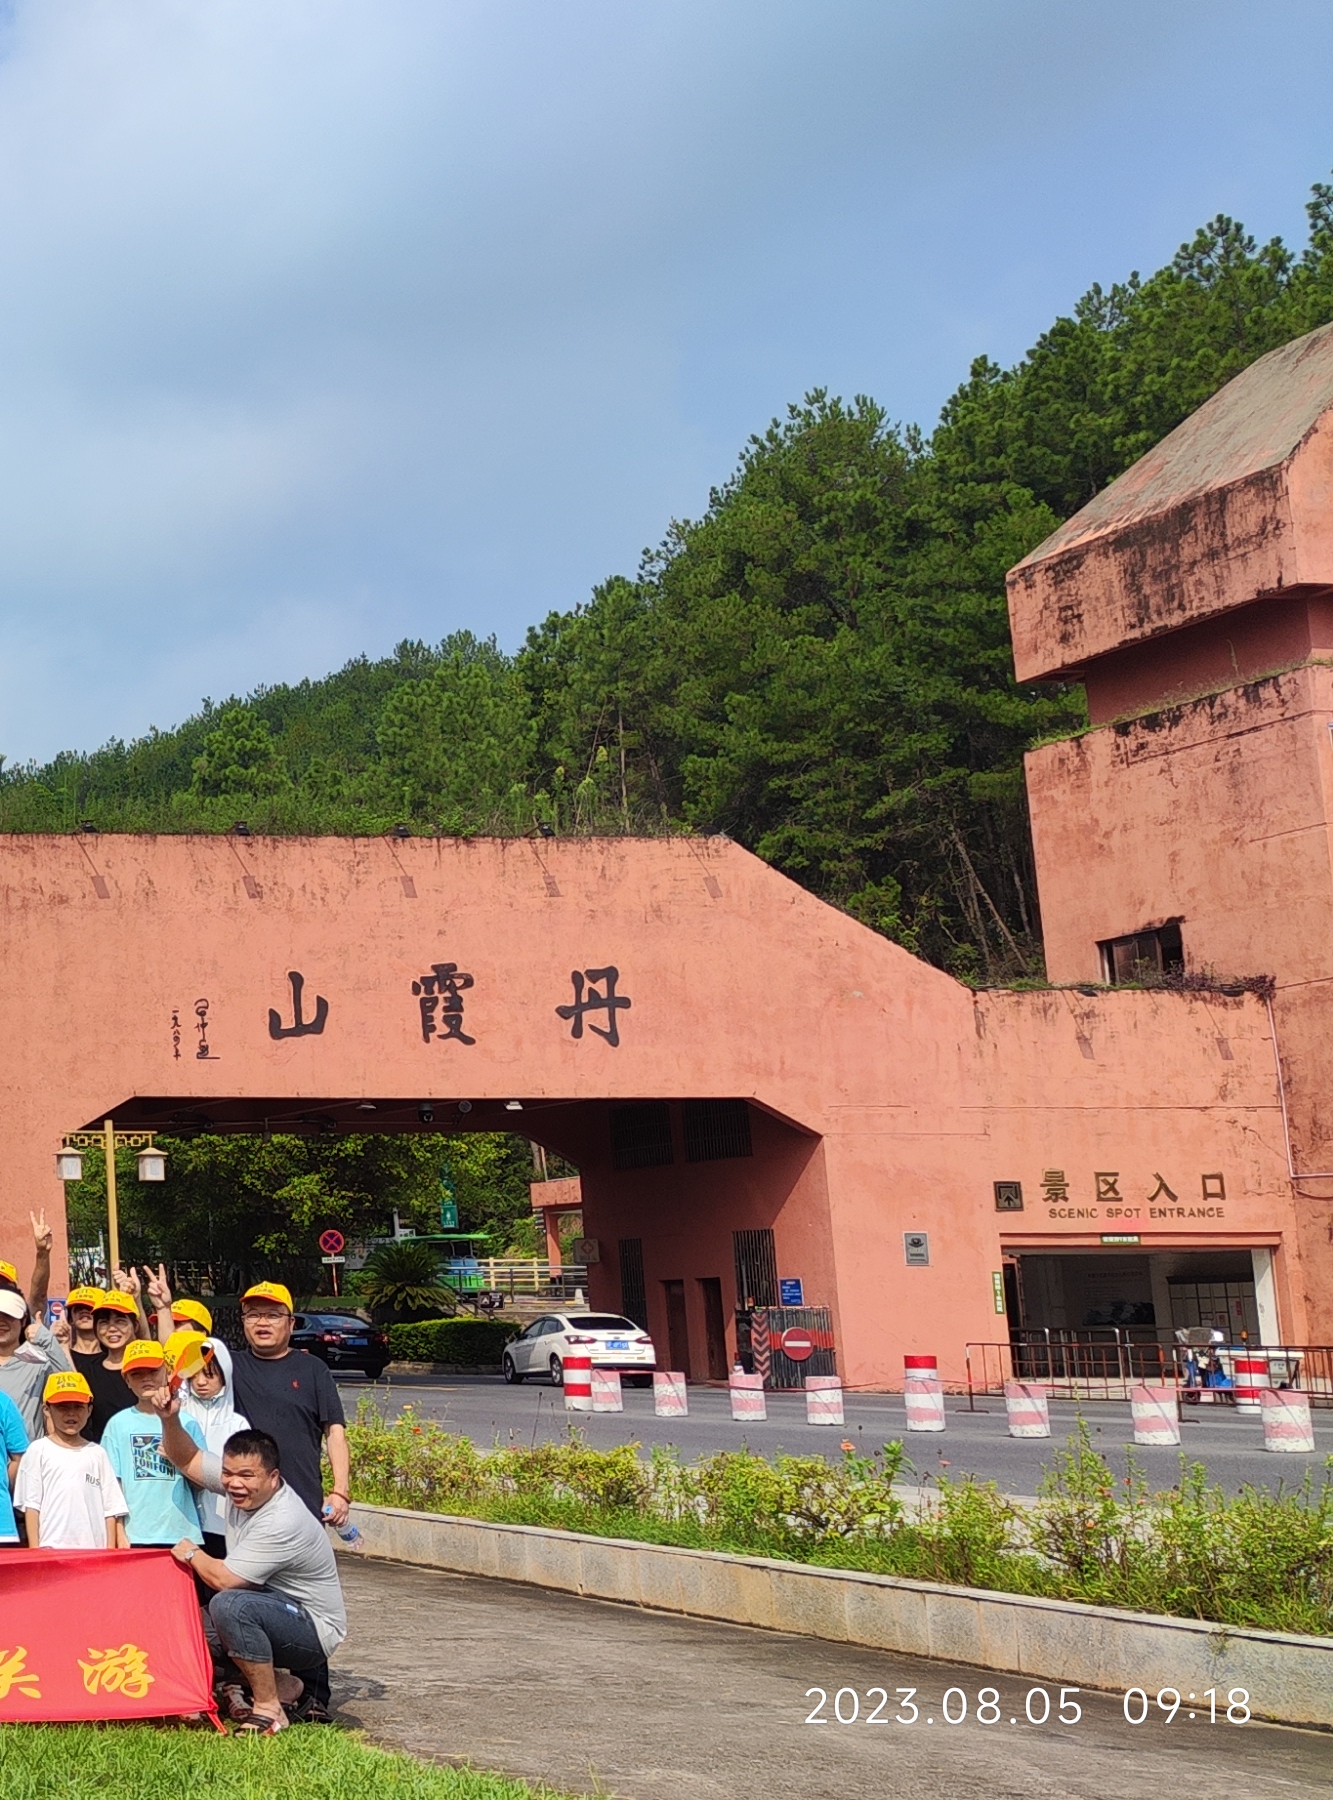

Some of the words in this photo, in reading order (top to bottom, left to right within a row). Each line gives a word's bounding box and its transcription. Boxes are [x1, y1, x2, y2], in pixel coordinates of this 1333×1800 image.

[1039, 1168, 1227, 1204] 景区入口
[1048, 1207, 1099, 1220] SCENIC
[1106, 1207, 1141, 1220] SPOT
[1149, 1206, 1225, 1220] ENTRANCE
